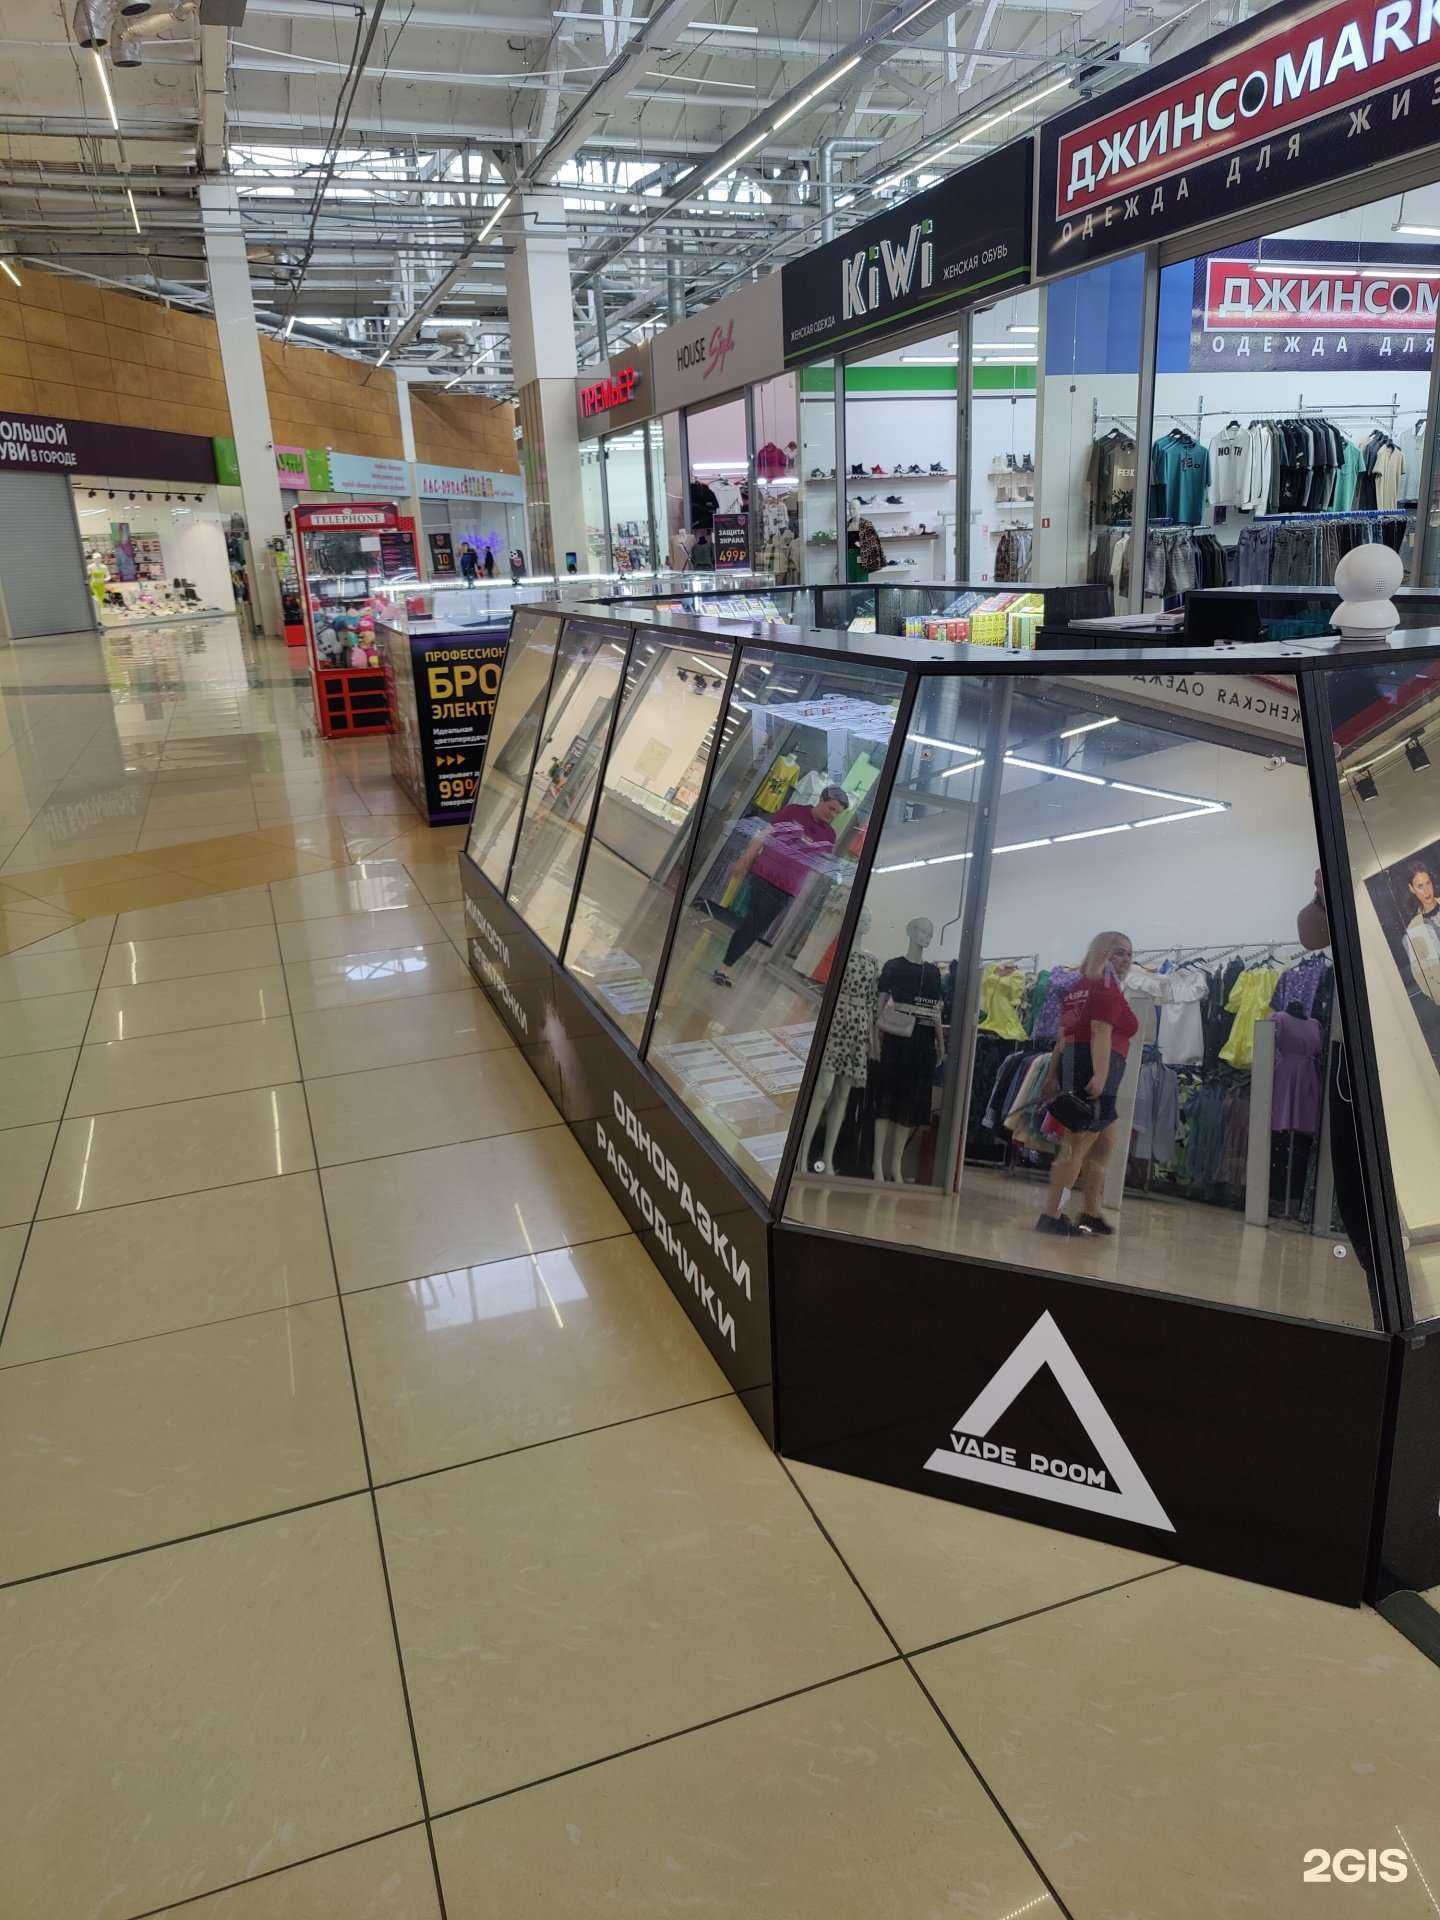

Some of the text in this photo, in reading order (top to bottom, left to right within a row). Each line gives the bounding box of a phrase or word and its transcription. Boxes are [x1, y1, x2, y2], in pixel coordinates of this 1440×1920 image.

[1061, 177, 1189, 244] ОДЕЖДА
[1226, 132, 1301, 189] ДЛЯ
[943, 243, 1008, 281] ЖЕНСКАЯ ОБУВЬ
[676, 338, 706, 372] HOUSE
[1212, 335, 1434, 357] ОДЕЖДА ДЛЯ
[0, 420, 68, 446] ОЛЬШОЙ
[31, 449, 38, 462] В
[39, 450, 78, 466] ГОРОДЕ
[313, 513, 381, 524] TELEPHONE
[718, 529, 745, 537] ЗАЩИТА
[427, 663, 502, 700] БРО
[612, 1089, 753, 1303] ОДНОРАЗКИ
[596, 1120, 737, 1354] РАСХОДНИКИ
[949, 1433, 1107, 1489] VAPE ROOM
